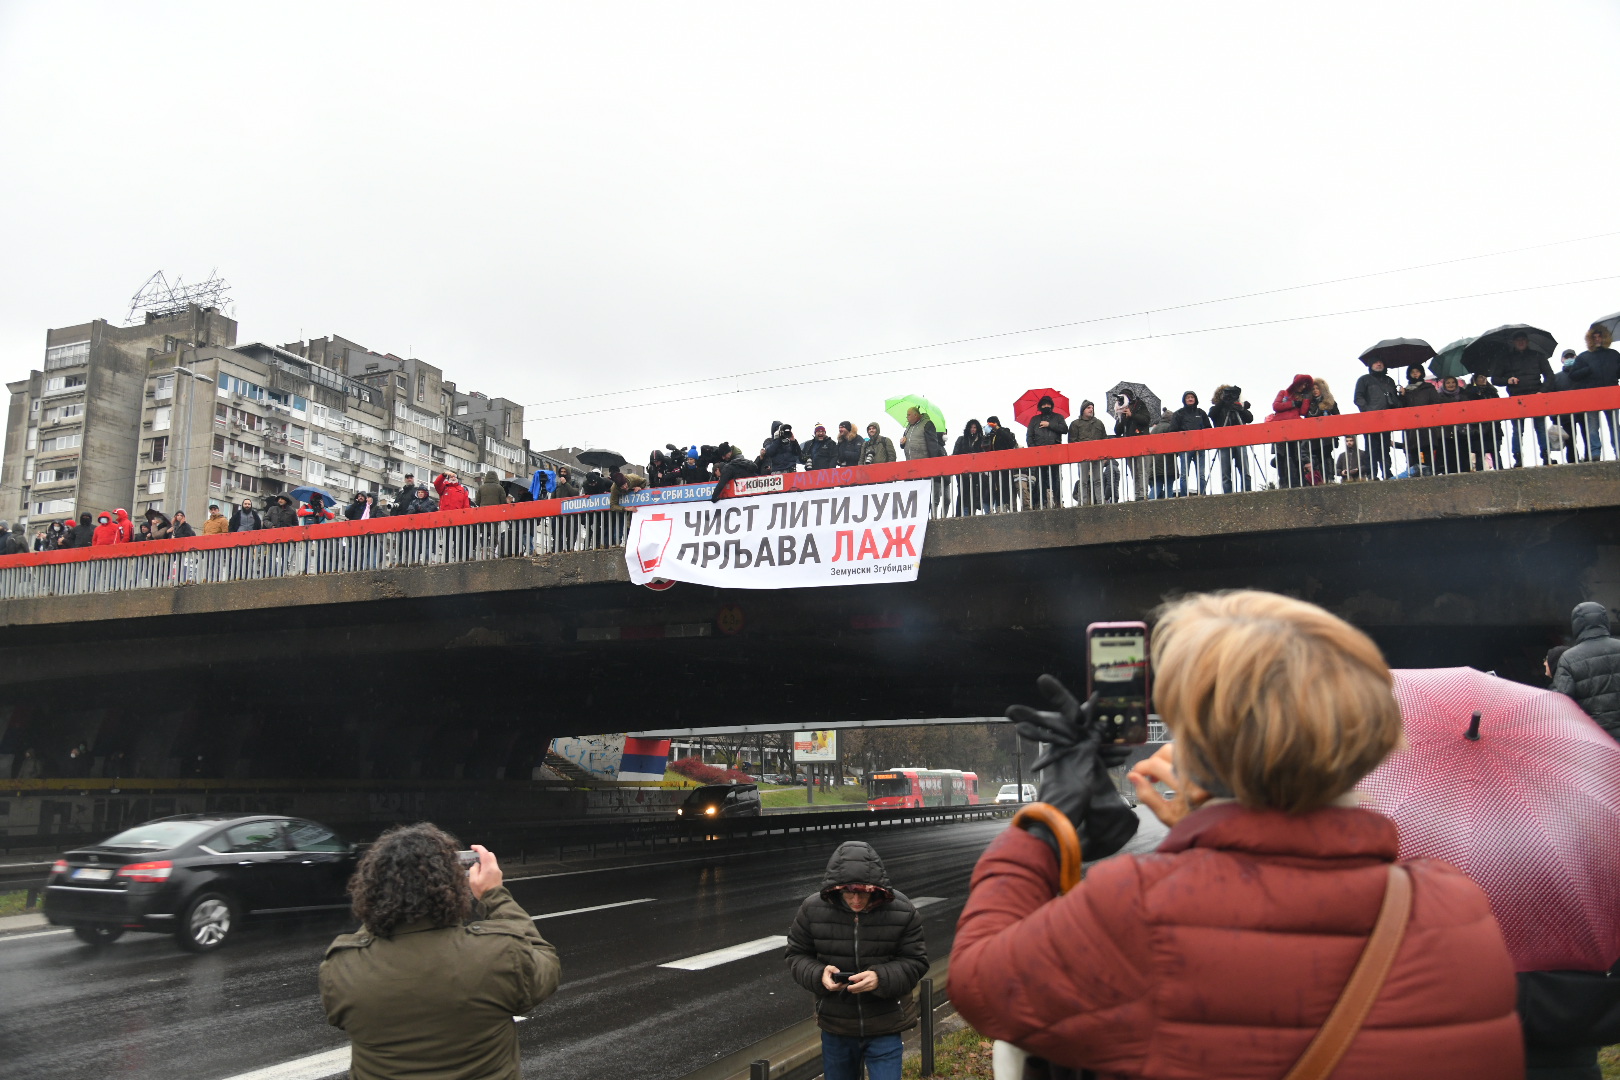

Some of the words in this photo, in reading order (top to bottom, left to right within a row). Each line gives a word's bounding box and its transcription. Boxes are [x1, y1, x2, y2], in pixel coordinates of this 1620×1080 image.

[563, 497, 600, 510] ПОШАЉИ
[631, 492, 649, 503] 7763
[661, 489, 682, 500] СРБИ
[684, 488, 694, 499] ЗА
[685, 505, 759, 537] ЧИСТ
[767, 490, 918, 531] ЛИТИЈУМ
[677, 533, 821, 570] ПРЉАВА
[832, 524, 917, 562] ЛАЖ
[830, 566, 871, 577] Земунски
